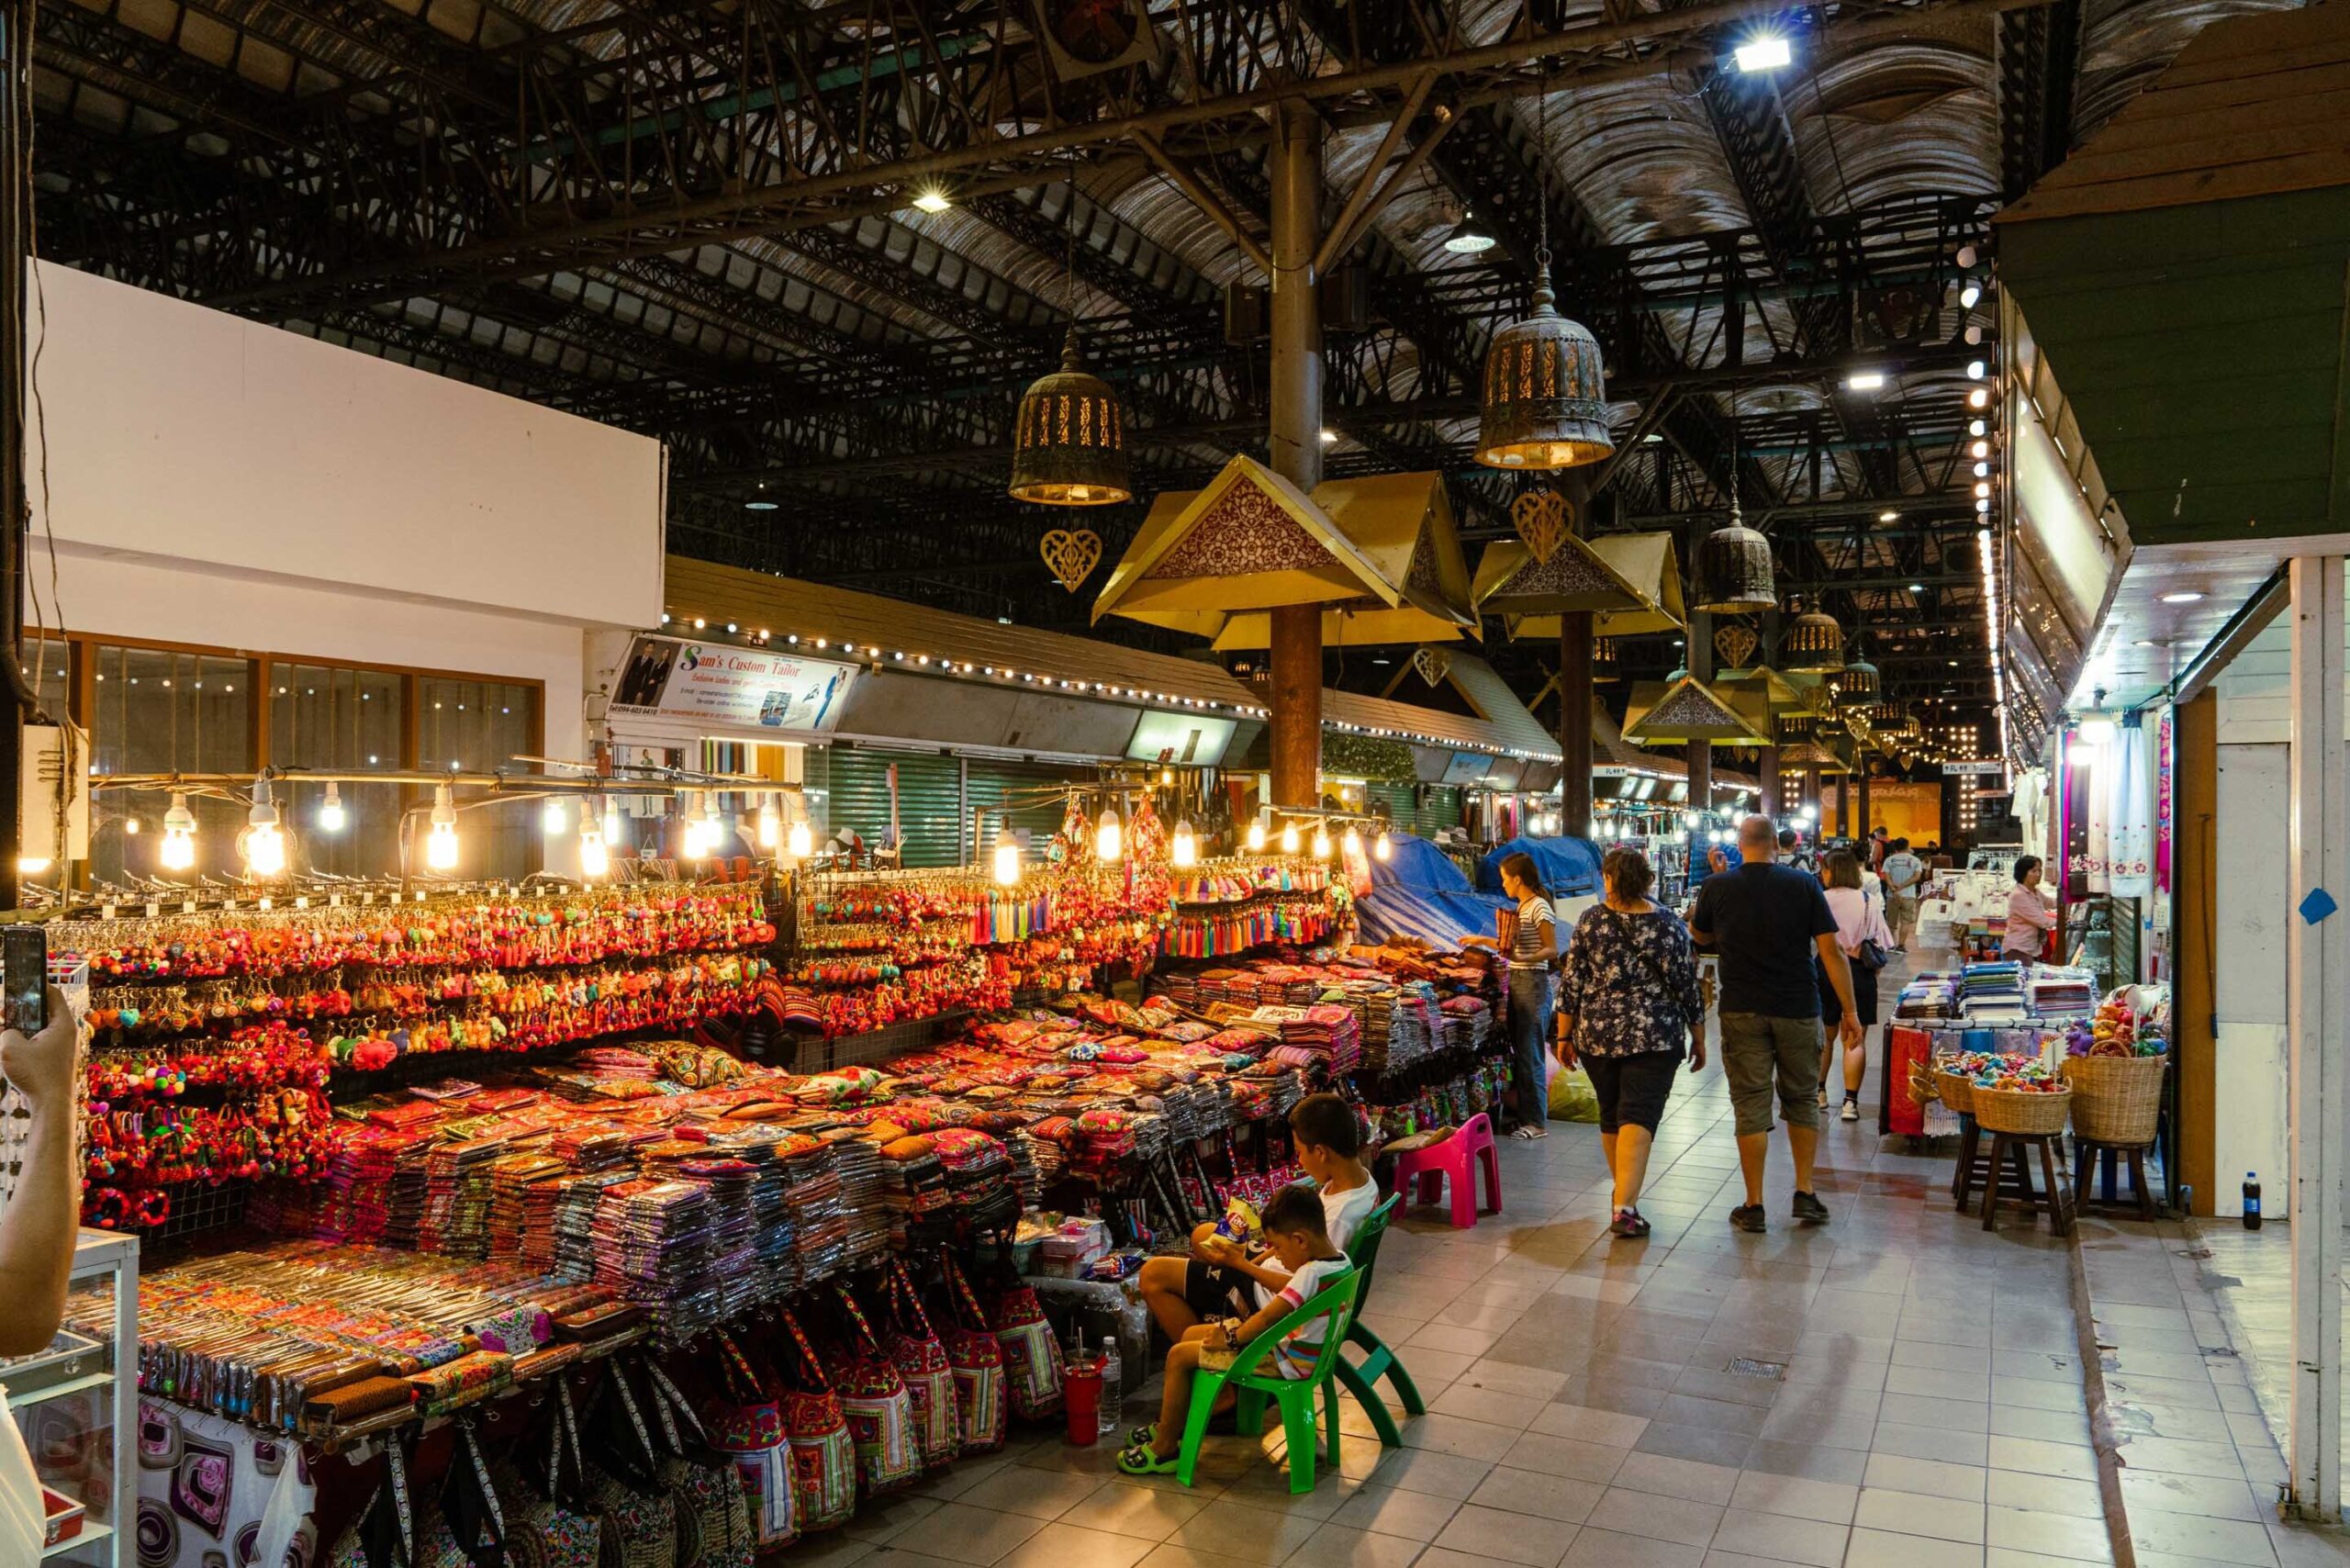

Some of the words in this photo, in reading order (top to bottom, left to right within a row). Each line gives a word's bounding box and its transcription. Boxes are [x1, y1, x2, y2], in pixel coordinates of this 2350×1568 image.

[680, 644, 723, 671] Sam's
[728, 656, 767, 676] Custom
[772, 661, 801, 678] Tailor
